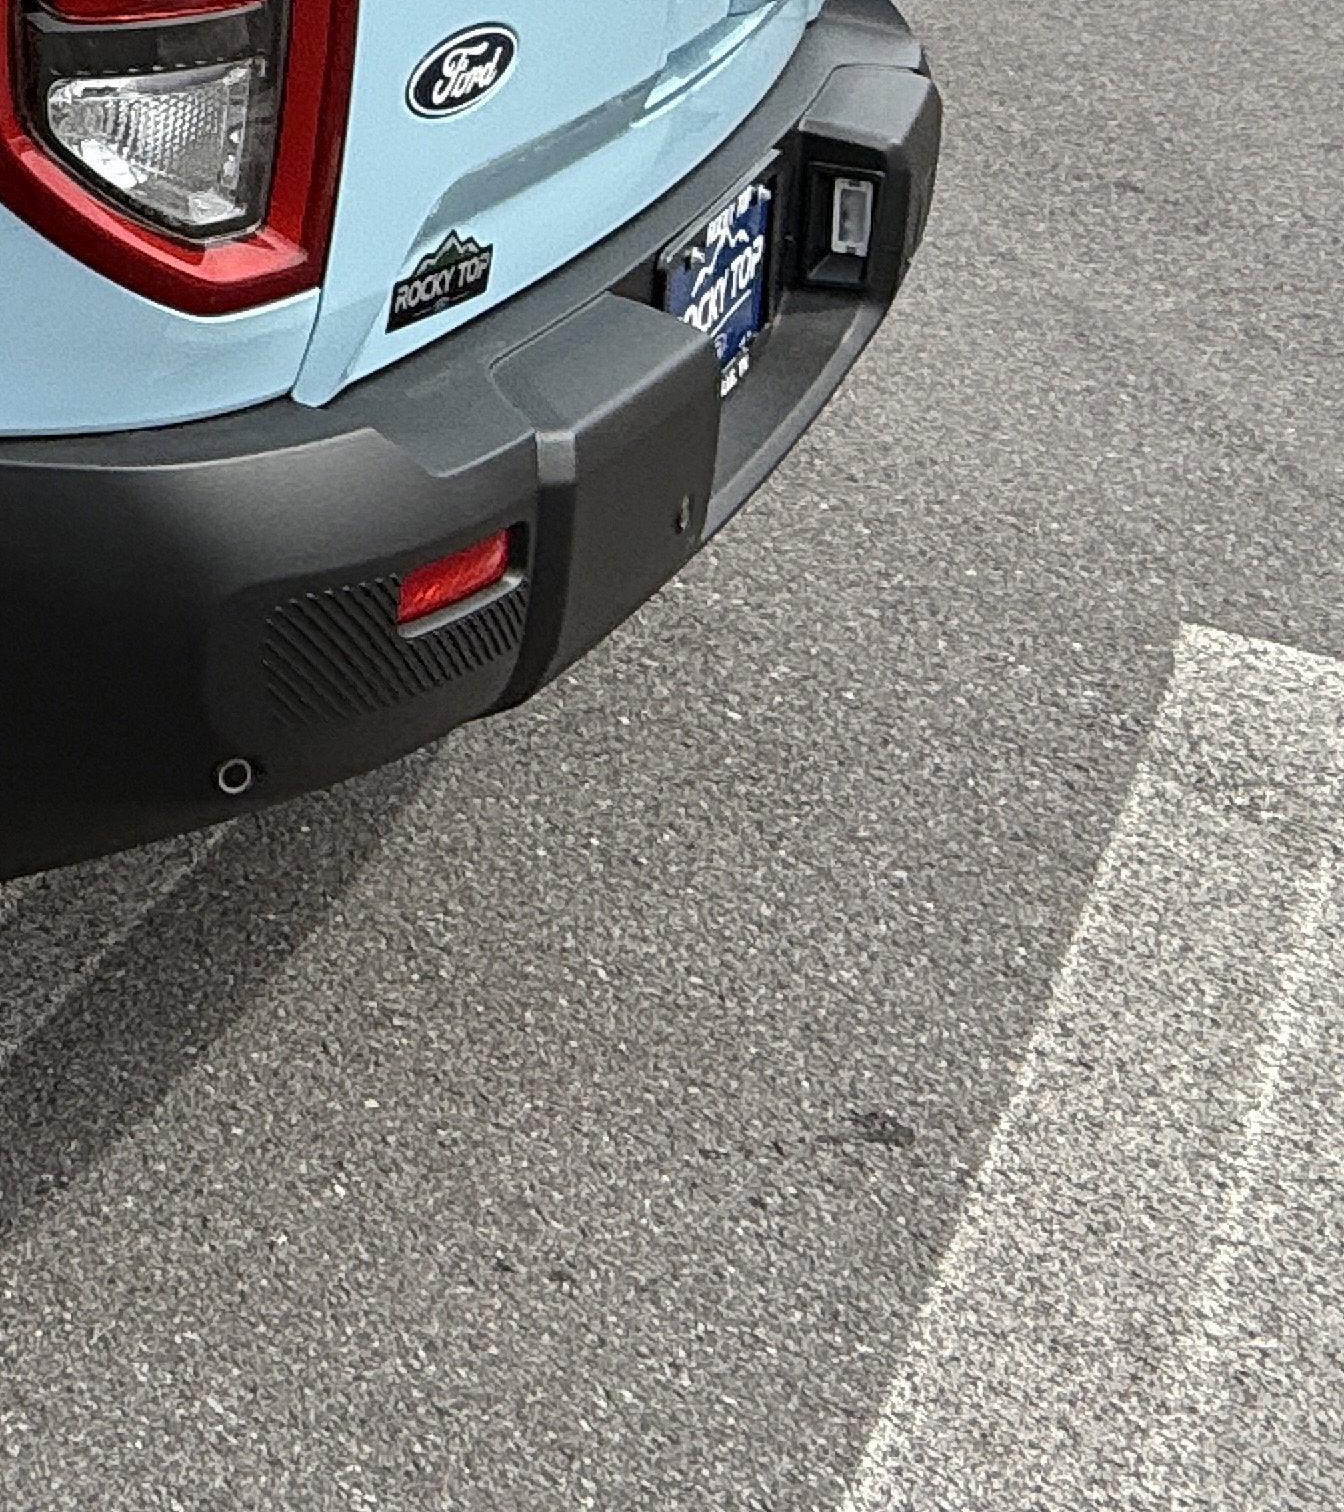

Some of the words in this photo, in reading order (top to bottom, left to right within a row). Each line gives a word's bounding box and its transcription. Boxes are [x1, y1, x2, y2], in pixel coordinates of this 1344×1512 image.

[432, 41, 503, 105] Ford
[394, 264, 456, 314] ROCKY
[458, 251, 490, 287] TOP
[678, 267, 730, 332] OCKY
[731, 234, 764, 299] TOP
